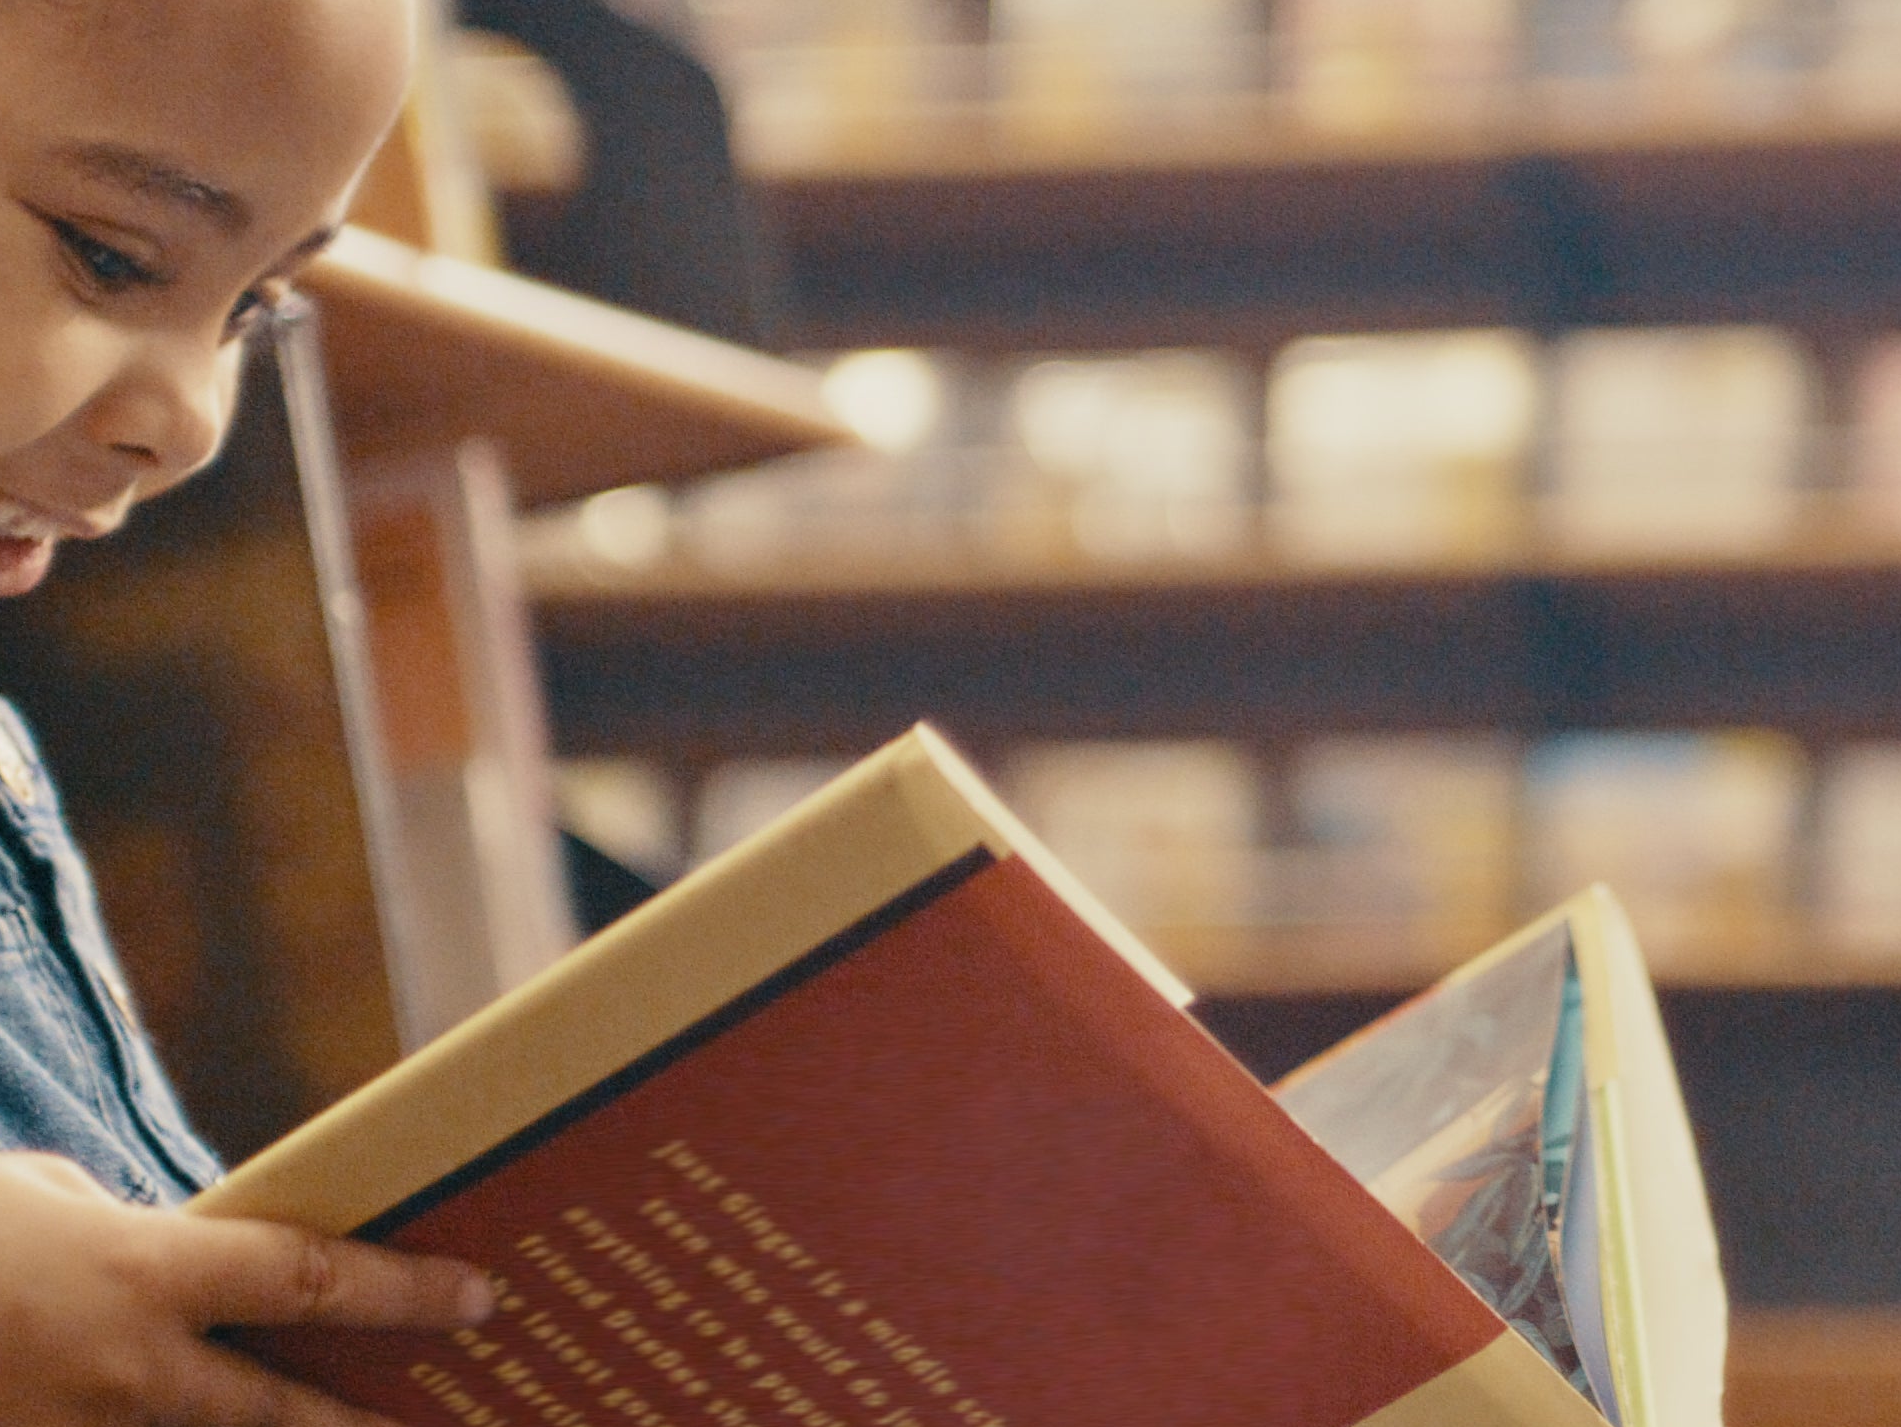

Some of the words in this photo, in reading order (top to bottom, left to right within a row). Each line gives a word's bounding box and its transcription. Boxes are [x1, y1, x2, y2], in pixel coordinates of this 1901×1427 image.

[513, 1232, 615, 1311] friend
[520, 1310, 616, 1386] latest
[560, 1205, 693, 1313] anything
[683, 1306, 728, 1339] to
[717, 1334, 767, 1372] be
[638, 1196, 713, 1255] teen
[705, 1253, 772, 1306] who
[764, 1304, 861, 1377] would
[844, 1375, 892, 1410] do
[718, 1190, 819, 1271] Ginger
[805, 1267, 849, 1300] is
[861, 1317, 959, 1397] middle
